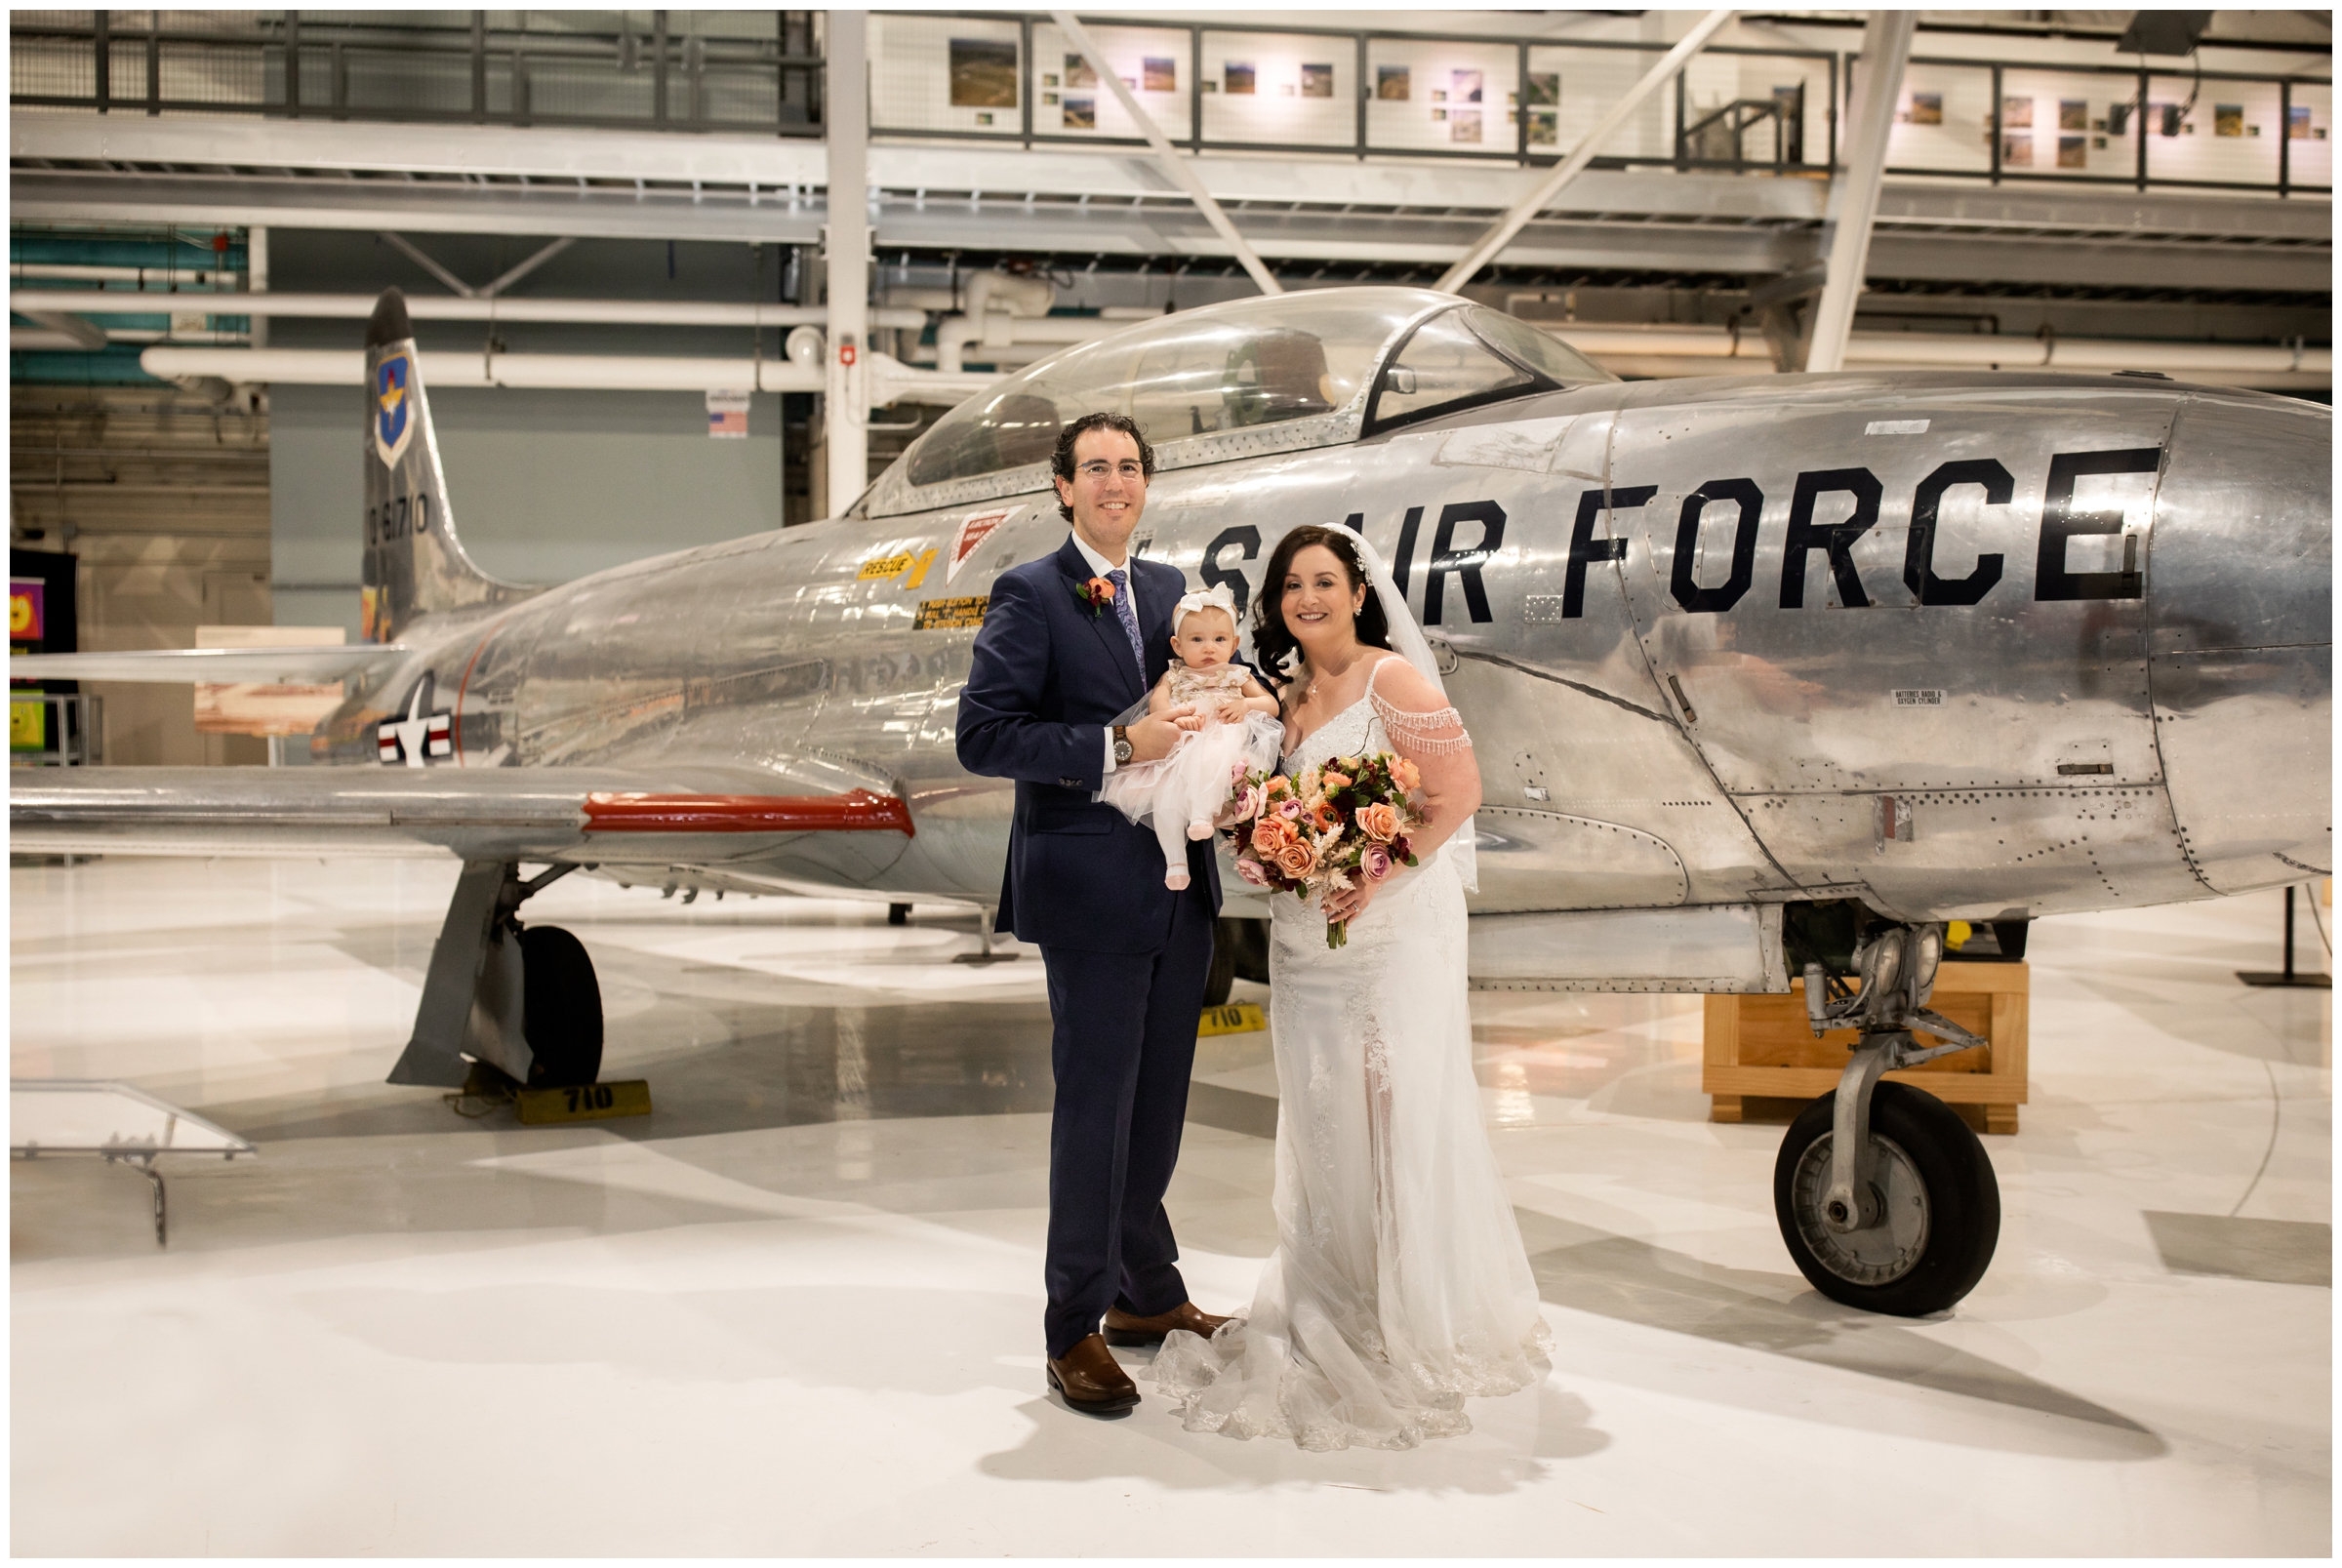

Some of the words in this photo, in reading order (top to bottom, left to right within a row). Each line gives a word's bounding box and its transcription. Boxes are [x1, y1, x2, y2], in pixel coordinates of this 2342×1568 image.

[1344, 500, 1508, 625] IR
[1561, 448, 2161, 619] FORCE
[861, 558, 908, 575] RESCUE
[953, 605, 979, 618] HANDLE
[1211, 1008, 1243, 1027] 710
[563, 1086, 614, 1113] 710
